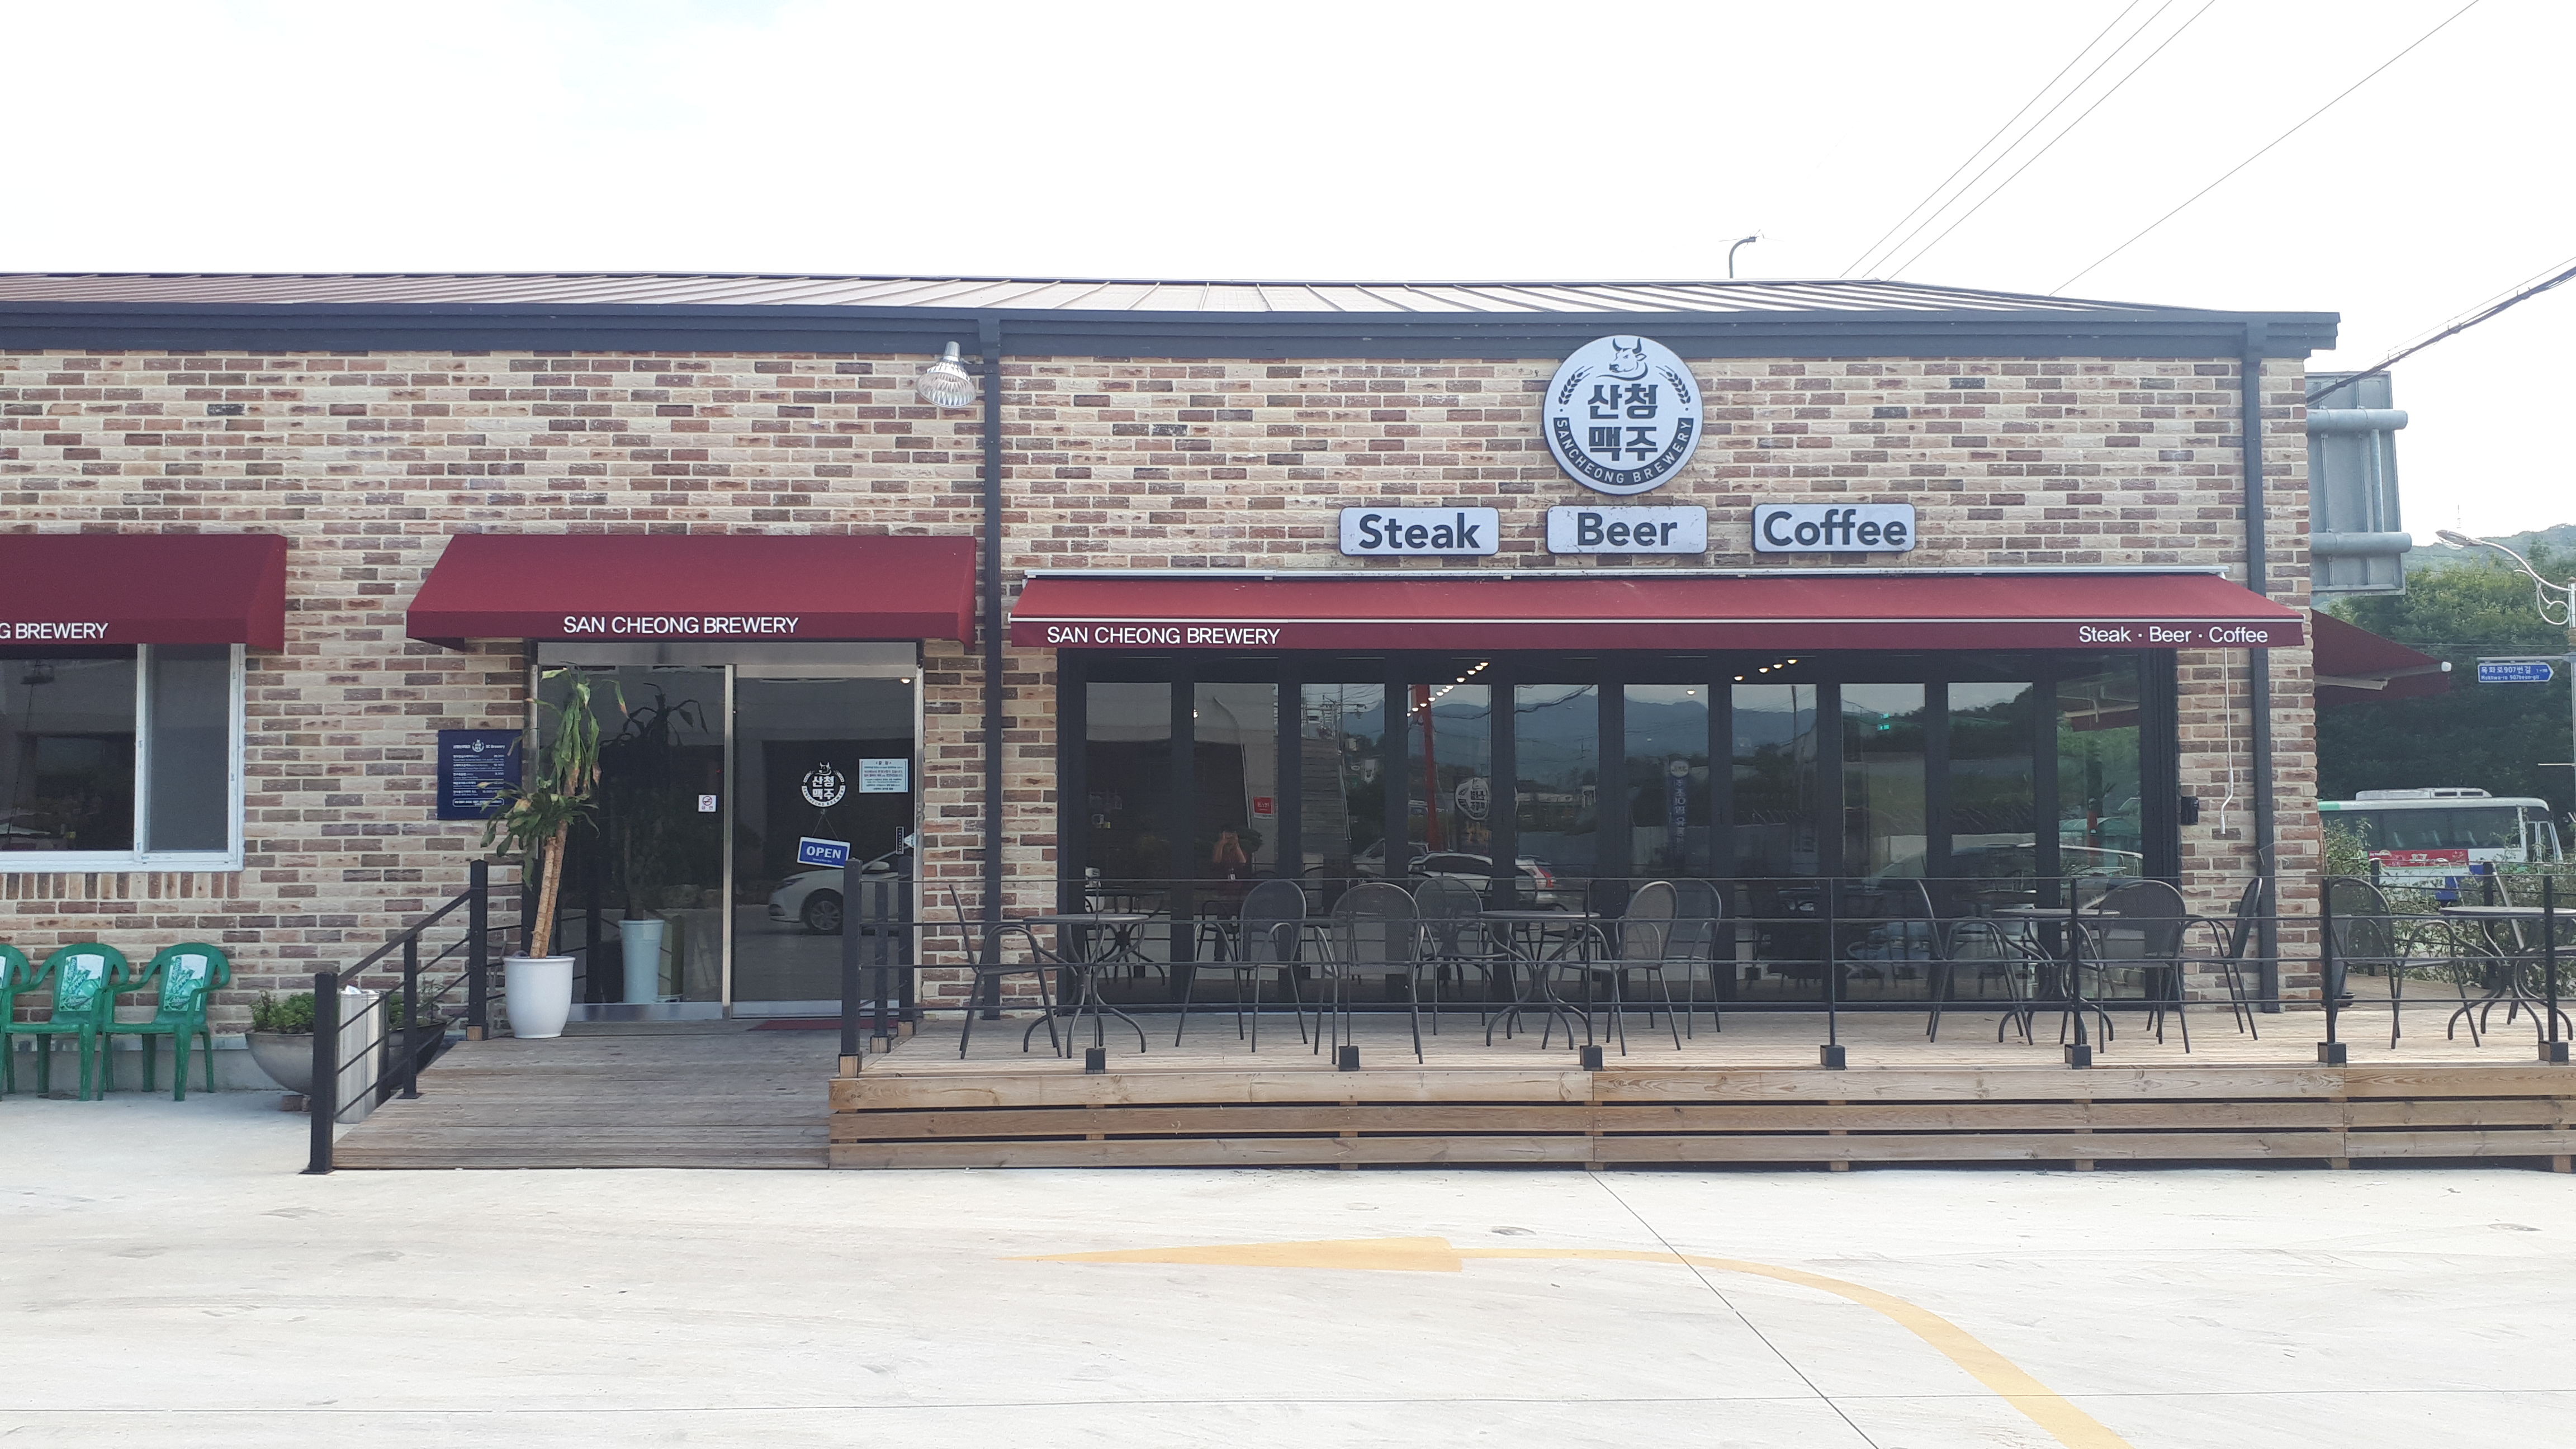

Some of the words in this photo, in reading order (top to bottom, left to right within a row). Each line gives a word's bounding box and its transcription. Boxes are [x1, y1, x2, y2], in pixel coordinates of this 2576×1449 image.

[1588, 383, 1658, 419] 산청
[1557, 420, 1624, 484] SANCHEONG
[1633, 422, 1692, 482] BREWERY
[1589, 427, 1658, 461] 맥주
[1358, 513, 1481, 549] Steak
[1576, 513, 1677, 546] Beer
[1763, 509, 1907, 546] Coffee
[16, 623, 109, 639] BREWERY
[564, 616, 605, 633] SAN
[612, 617, 699, 633] CHEONG
[704, 617, 799, 633] BREWERY
[1047, 627, 1088, 643] SAN
[1095, 627, 1180, 644] CHEONG
[1187, 628, 1281, 645] BREWERY
[2079, 626, 2132, 642] Steak
[2149, 626, 2192, 642] Beer
[2209, 627, 2268, 642] Coffee
[2481, 666, 2531, 674] 목화로907번길
[812, 776, 835, 787] 산청
[812, 789, 835, 800] 맥주
[807, 846, 842, 859] OPEN
